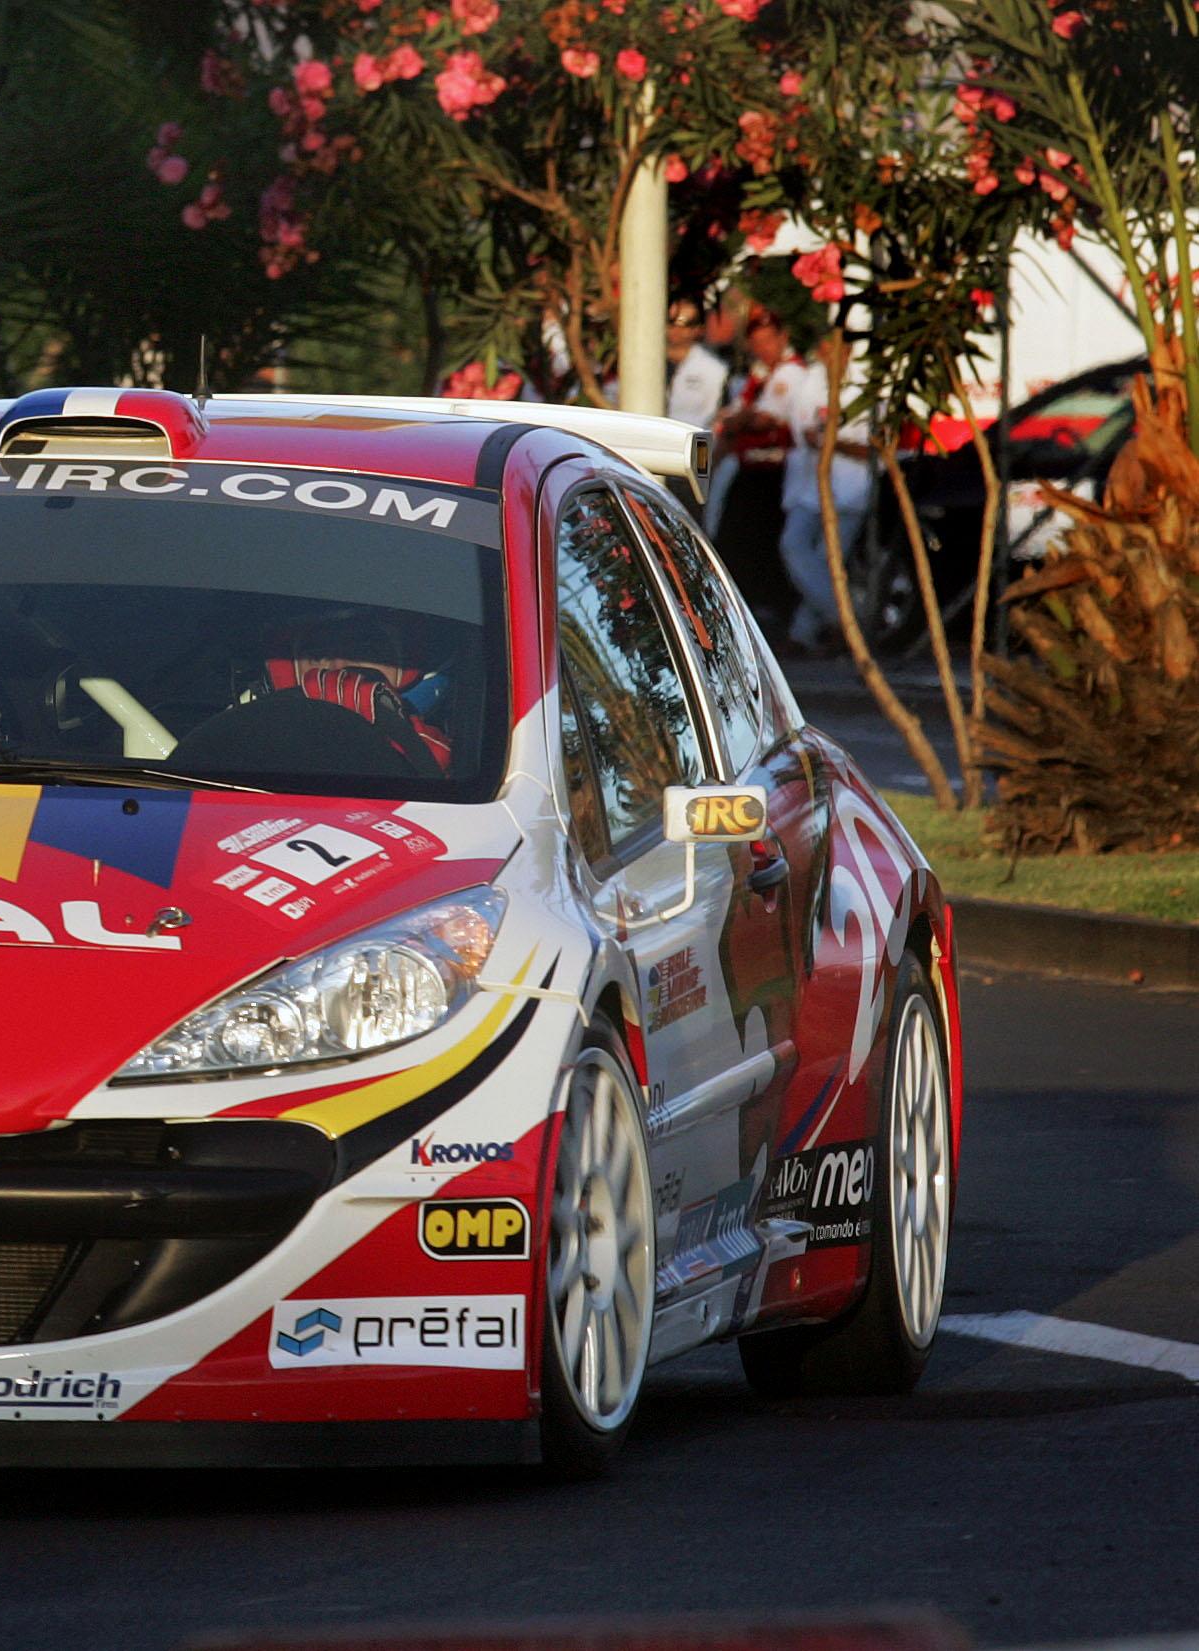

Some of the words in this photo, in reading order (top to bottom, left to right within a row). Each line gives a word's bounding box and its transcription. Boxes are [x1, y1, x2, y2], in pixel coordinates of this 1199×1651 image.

[286, 839, 352, 867] 2
[410, 1131, 515, 1166] KRONOS
[811, 1146, 874, 1208] meo
[425, 1208, 523, 1248] OMP
